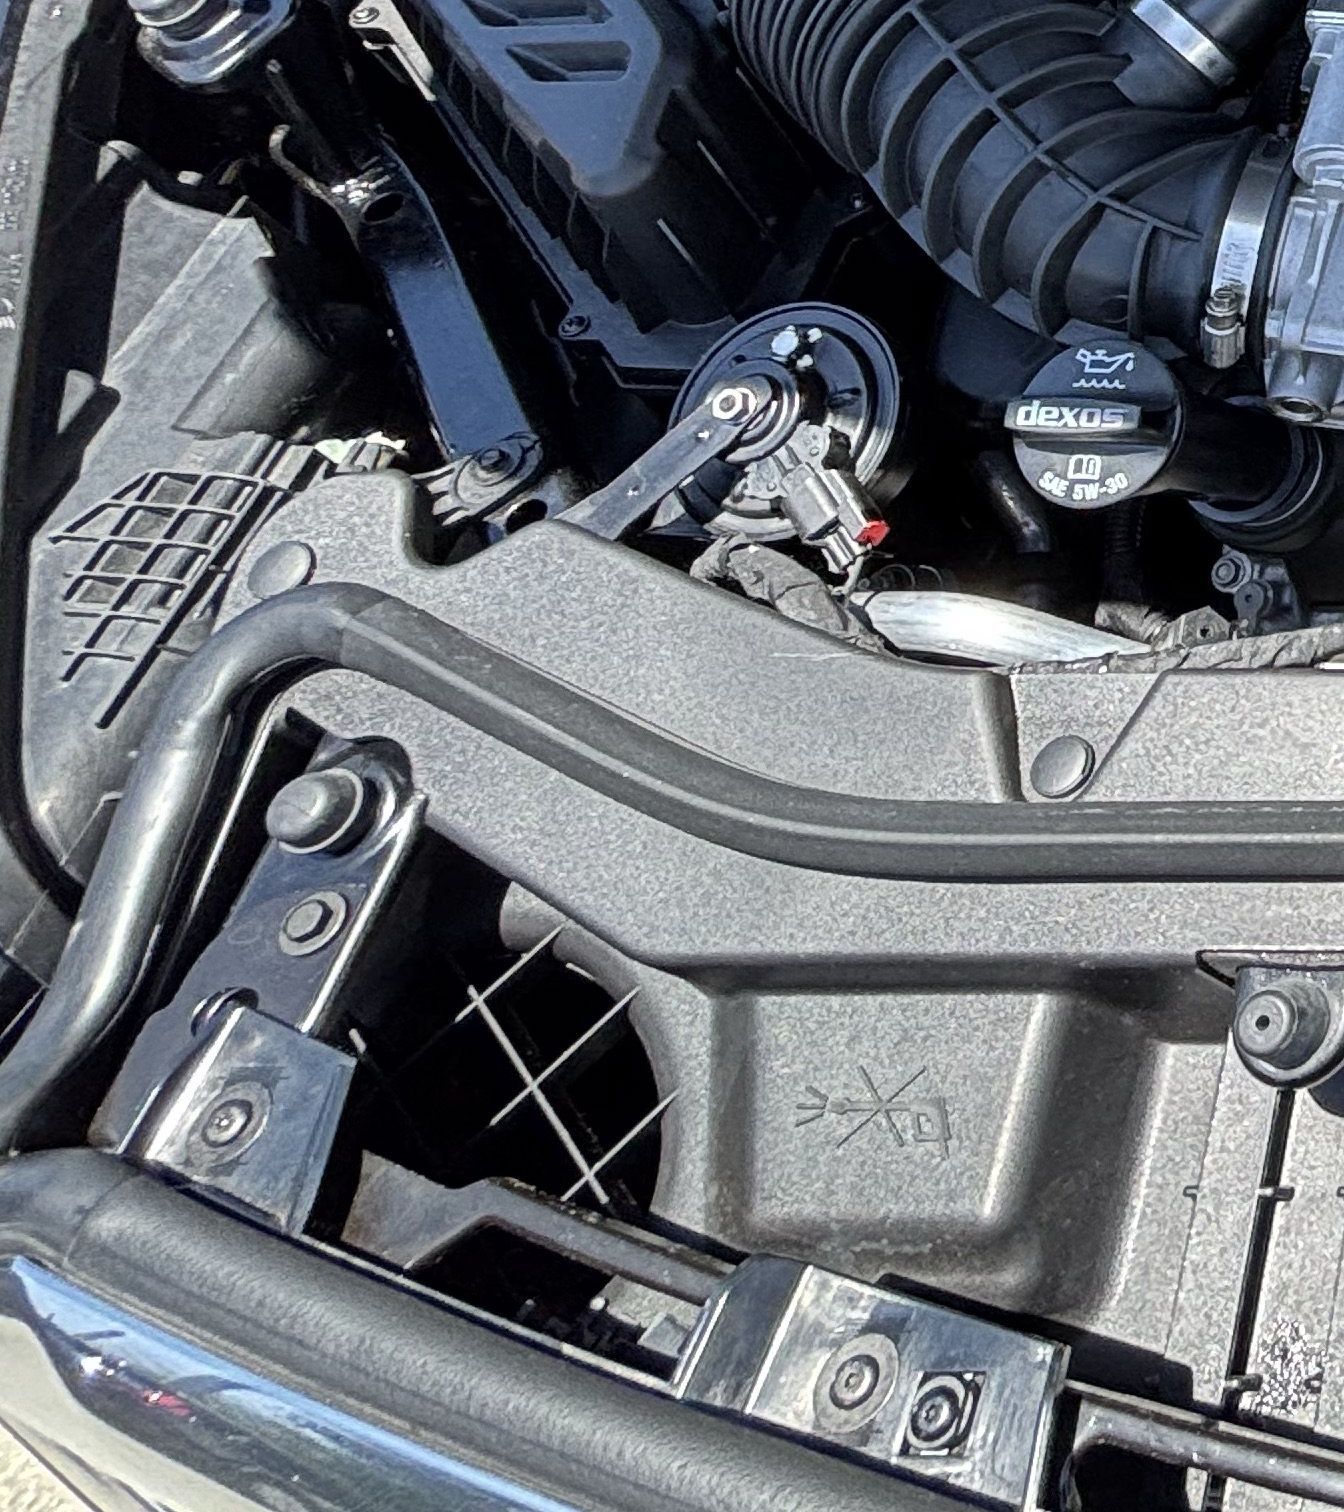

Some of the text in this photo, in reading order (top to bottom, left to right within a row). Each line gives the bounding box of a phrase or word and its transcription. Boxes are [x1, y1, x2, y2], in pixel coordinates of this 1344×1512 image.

[1016, 400, 1128, 428] dexos
[1038, 471, 1128, 501] SAE 5W-30
